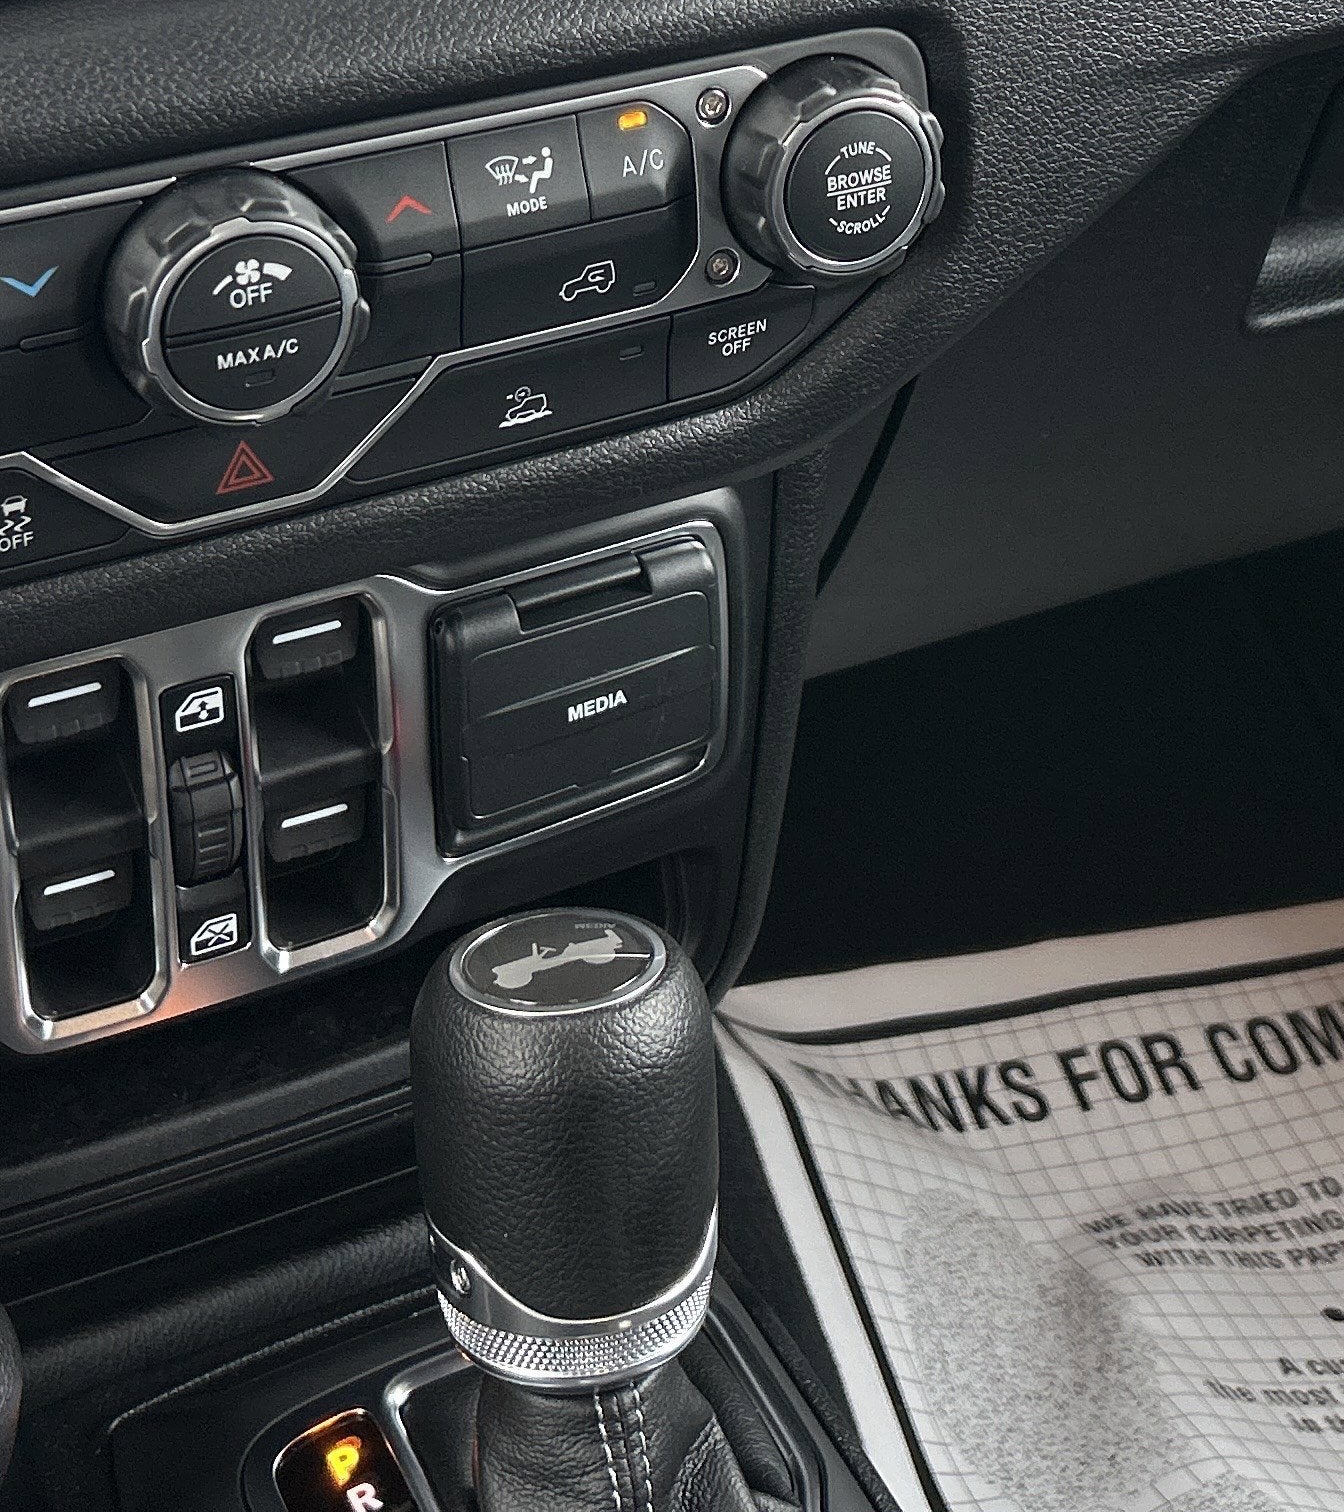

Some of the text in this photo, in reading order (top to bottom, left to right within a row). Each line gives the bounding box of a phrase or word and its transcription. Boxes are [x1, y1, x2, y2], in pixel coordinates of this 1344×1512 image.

[621, 147, 665, 180] A/C
[839, 140, 877, 159] TUNE
[827, 163, 892, 192] BROWSE
[505, 194, 549, 217] MODE
[837, 187, 887, 211] ENTER
[836, 213, 886, 235] SCROLL
[229, 281, 273, 309] OFF
[706, 319, 769, 350] SCREEN
[720, 338, 753, 358] OFF
[217, 337, 300, 370] MAX A/C
[566, 687, 629, 724] MEDIA
[1055, 1030, 1204, 1113] FOR
[1083, 1211, 1128, 1236] WE
[1136, 1198, 1213, 1223] HAVE
[1217, 1186, 1300, 1220] TRIED
[1301, 1175, 1344, 1204] TO
[1098, 1223, 1184, 1252] YOUR
[1135, 1247, 1216, 1270] WITH
[1220, 1248, 1286, 1272] THIS
[1277, 1356, 1302, 1377] A
[1202, 1377, 1258, 1404] the
[1261, 1383, 1340, 1409] most
[326, 1445, 360, 1488] P
[346, 1482, 384, 1512] R
